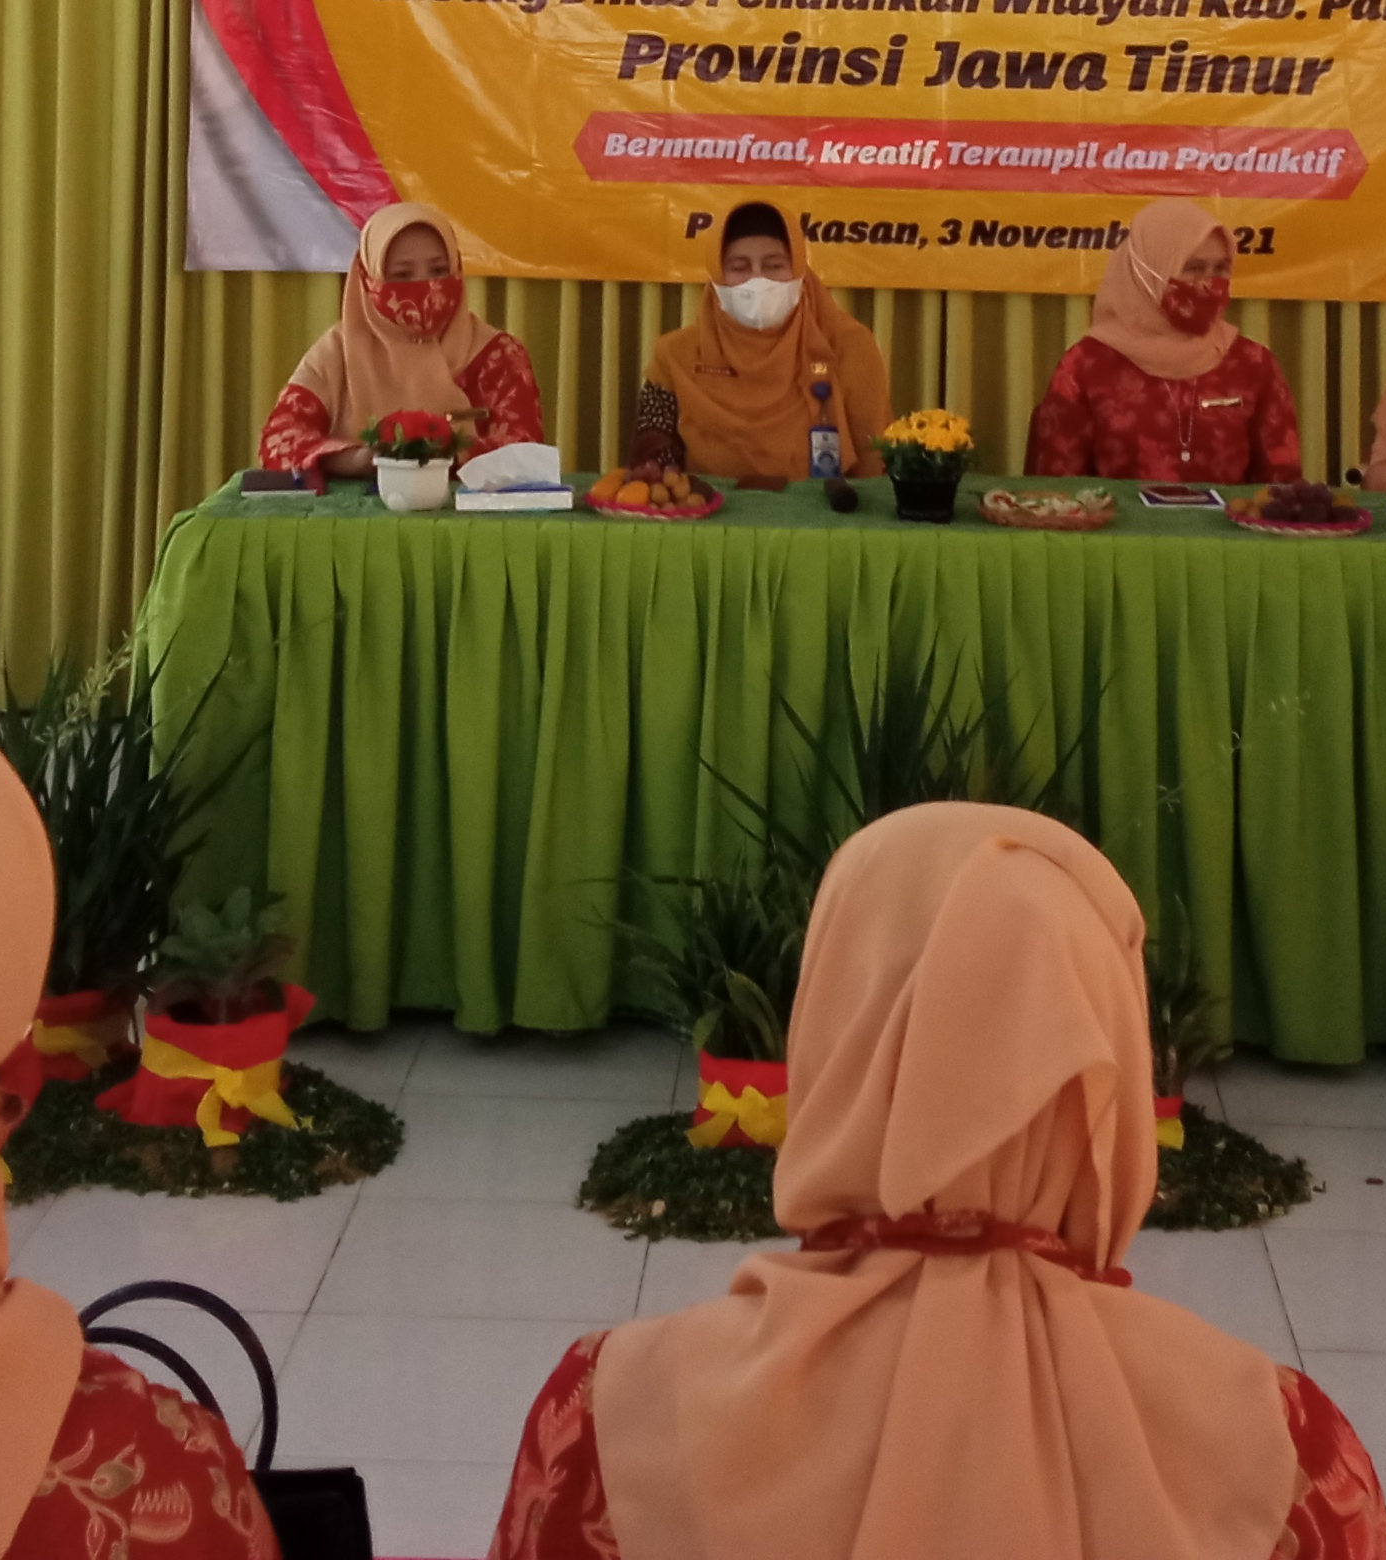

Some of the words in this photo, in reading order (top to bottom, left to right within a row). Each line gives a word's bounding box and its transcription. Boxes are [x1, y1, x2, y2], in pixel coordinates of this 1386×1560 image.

[618, 32, 907, 85] Provinsi
[925, 42, 1107, 91] Jawa
[1125, 41, 1333, 94] Timur
[605, 134, 814, 164] Bermanfaat,
[820, 140, 942, 169] Kreatif,
[948, 143, 1098, 173] Terampil
[1103, 144, 1168, 169] dan
[1175, 147, 1345, 177] Produktif
[686, 212, 928, 251] Pkasan,
[938, 219, 962, 245] 3
[969, 220, 1129, 250] Novemb
